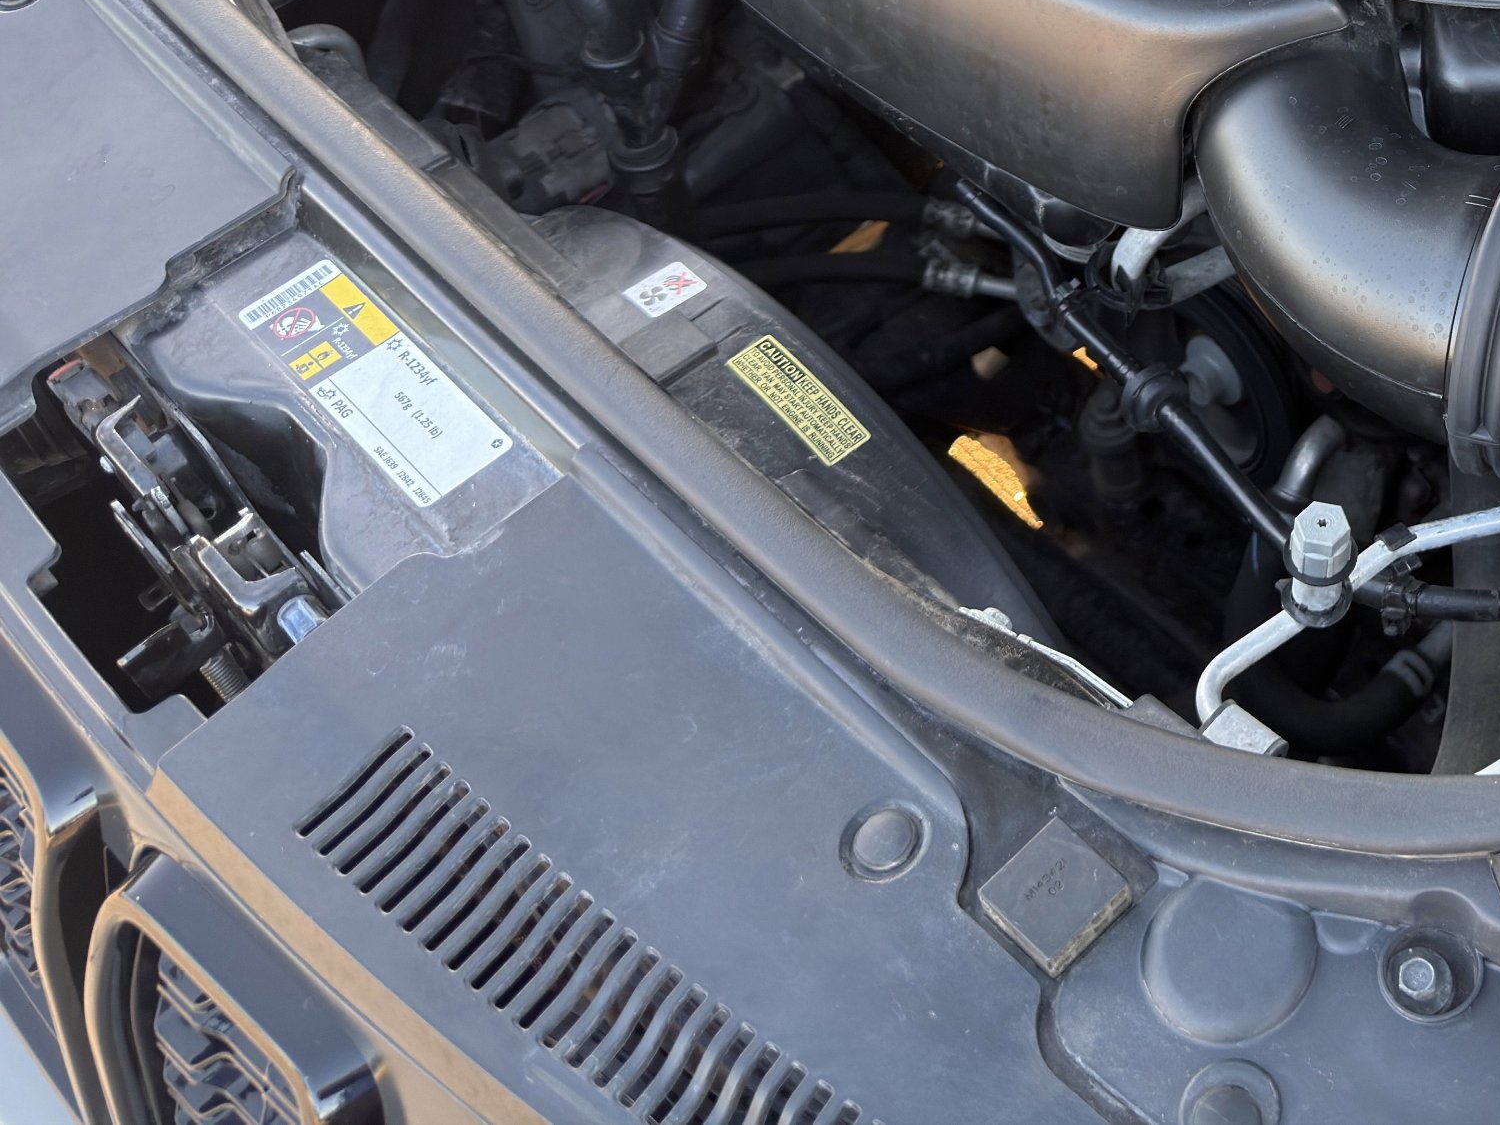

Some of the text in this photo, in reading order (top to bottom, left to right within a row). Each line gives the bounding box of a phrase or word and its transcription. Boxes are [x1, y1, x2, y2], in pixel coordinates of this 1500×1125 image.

[333, 337, 357, 360] R-1234yf
[398, 349, 438, 386] R-1234yf
[331, 399, 353, 419] PAG
[394, 391, 443, 440] 567g (1.25 lb)
[735, 357, 836, 458] WHETHER OR NOT ENGINE IS RUNNING
[750, 348, 760, 357] TO
[757, 355, 775, 371] AVOID
[772, 368, 800, 396] PERSONAL
[817, 413, 833, 430] KEEP
[830, 427, 852, 449] HANDS
[760, 339, 864, 442] CAUTION KEEP HANDS CLEAR
[761, 370, 775, 383] FAN
[773, 382, 787, 395] MAY
[784, 393, 804, 412] START
[799, 409, 845, 454] AUTOMATICALLY
[373, 446, 432, 504] SAE J639 J2842 J2845
